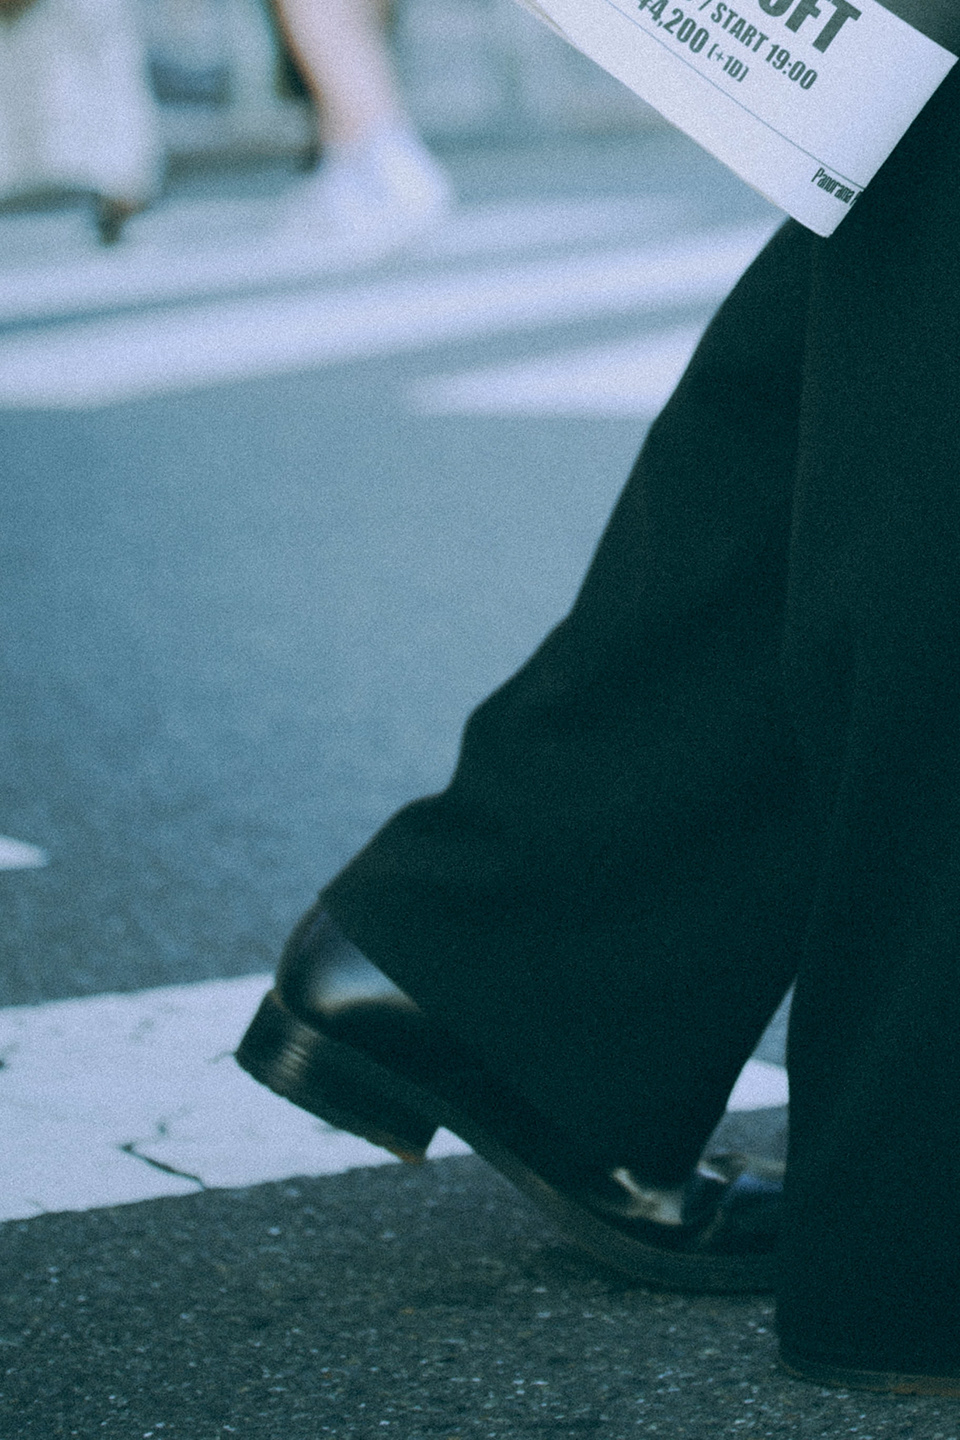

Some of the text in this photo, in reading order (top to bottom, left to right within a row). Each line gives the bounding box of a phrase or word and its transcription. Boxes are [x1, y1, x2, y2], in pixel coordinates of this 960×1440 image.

[706, 42, 750, 83] (+1D)
[710, 1, 769, 53] START
[765, 44, 818, 91] 19:00
[811, 167, 856, 205] Panorama
